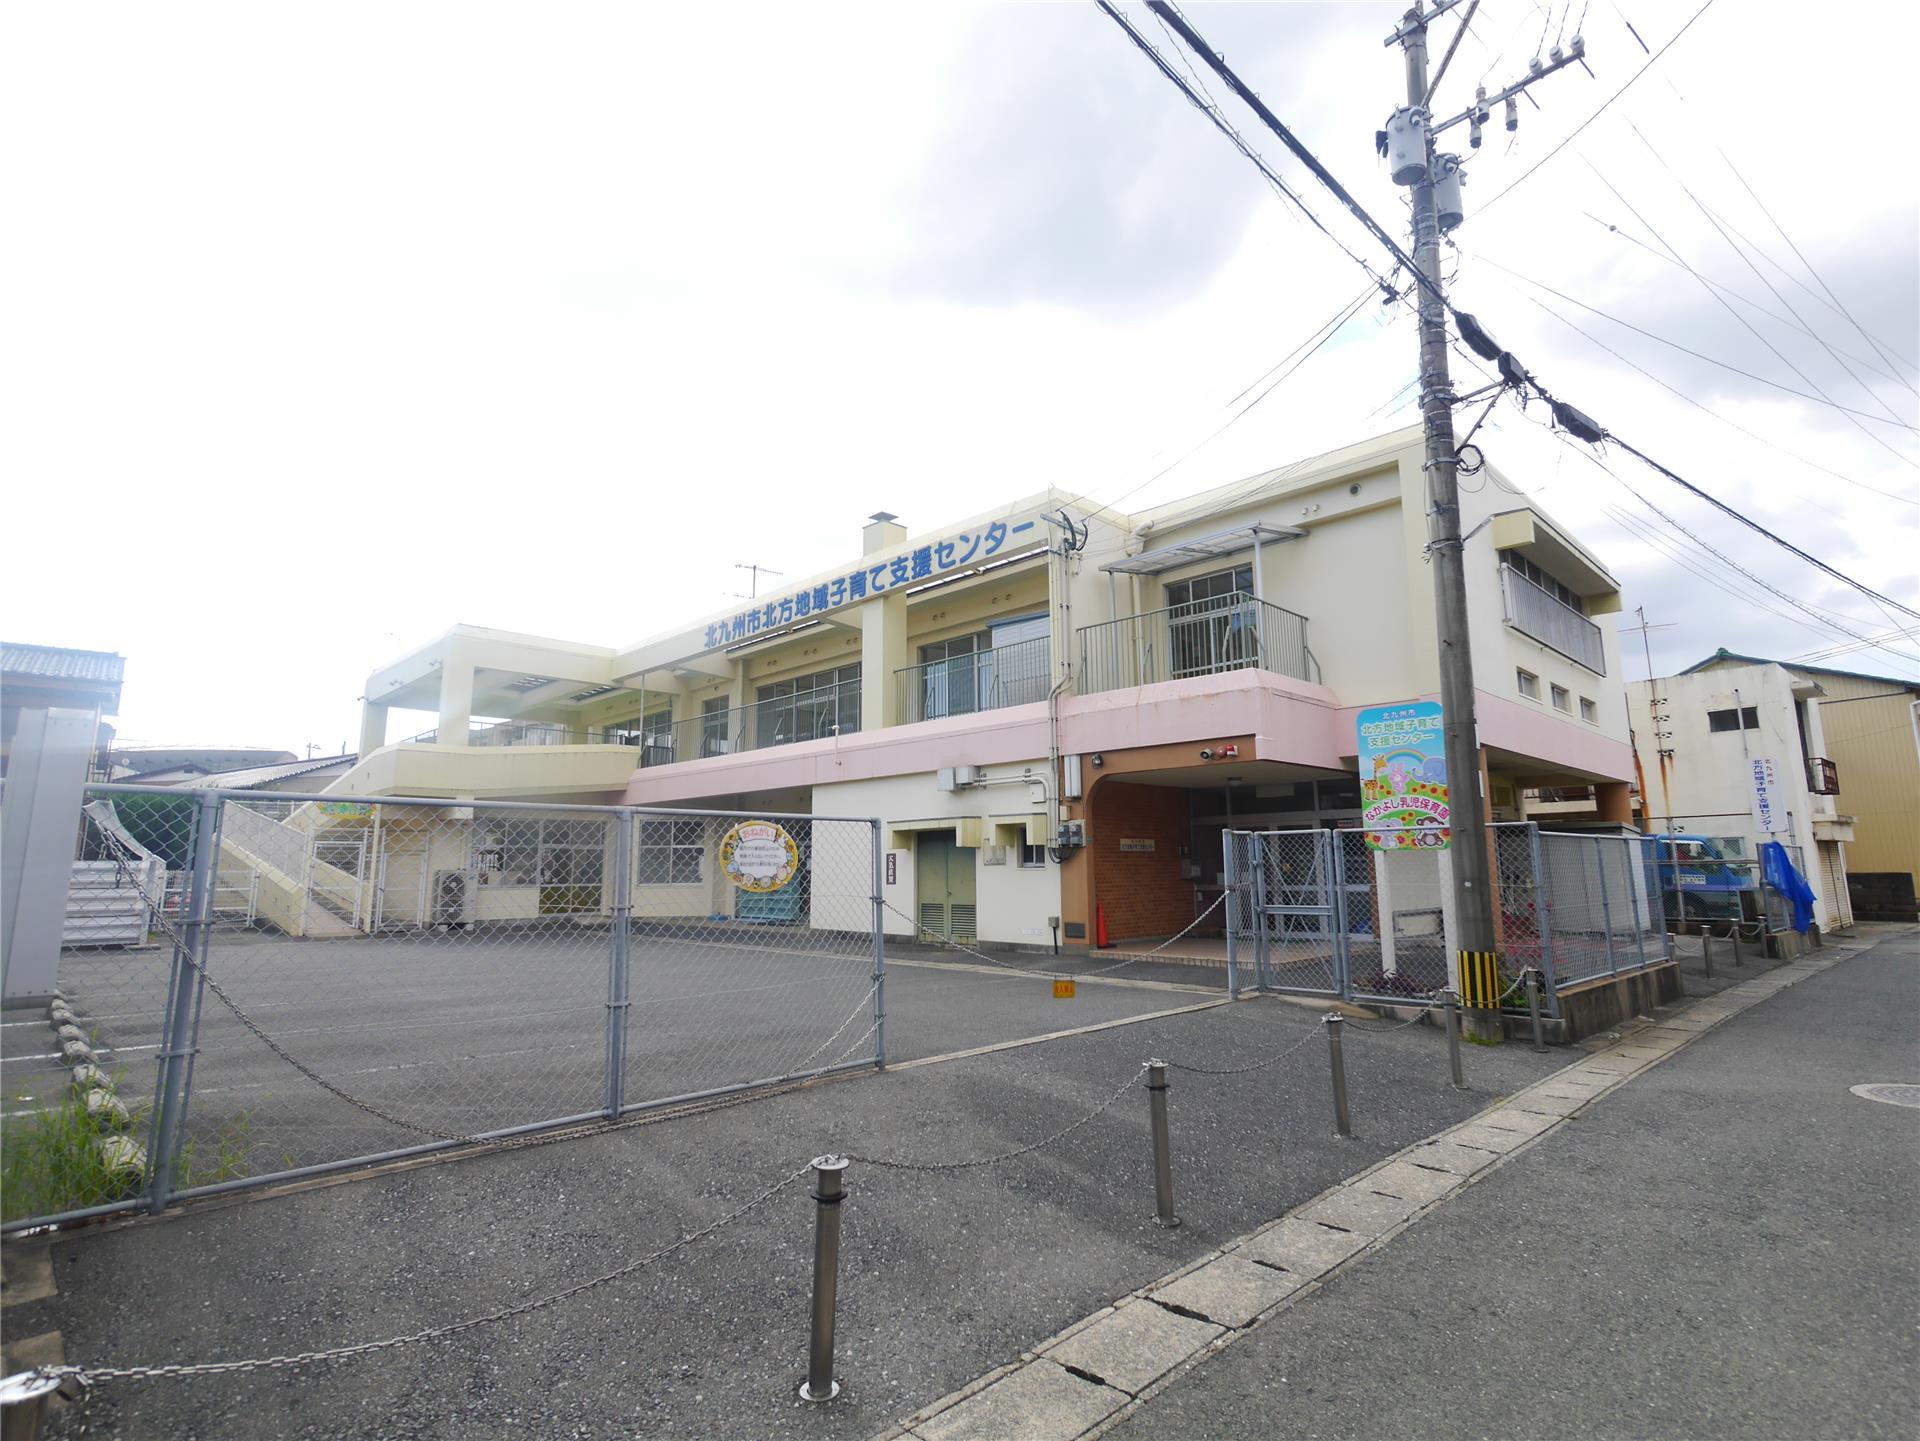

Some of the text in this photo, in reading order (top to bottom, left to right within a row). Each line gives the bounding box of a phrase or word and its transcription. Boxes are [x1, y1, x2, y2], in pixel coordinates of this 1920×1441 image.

[704, 521, 1035, 649] 北九州市北方地域子育て支援センター
[1383, 709, 1416, 720] 北九州市
[1362, 717, 1440, 735] 北方地域子育て
[1370, 734, 1434, 747] 支援センター
[1366, 797, 1449, 821] なかよし乳児保育園
